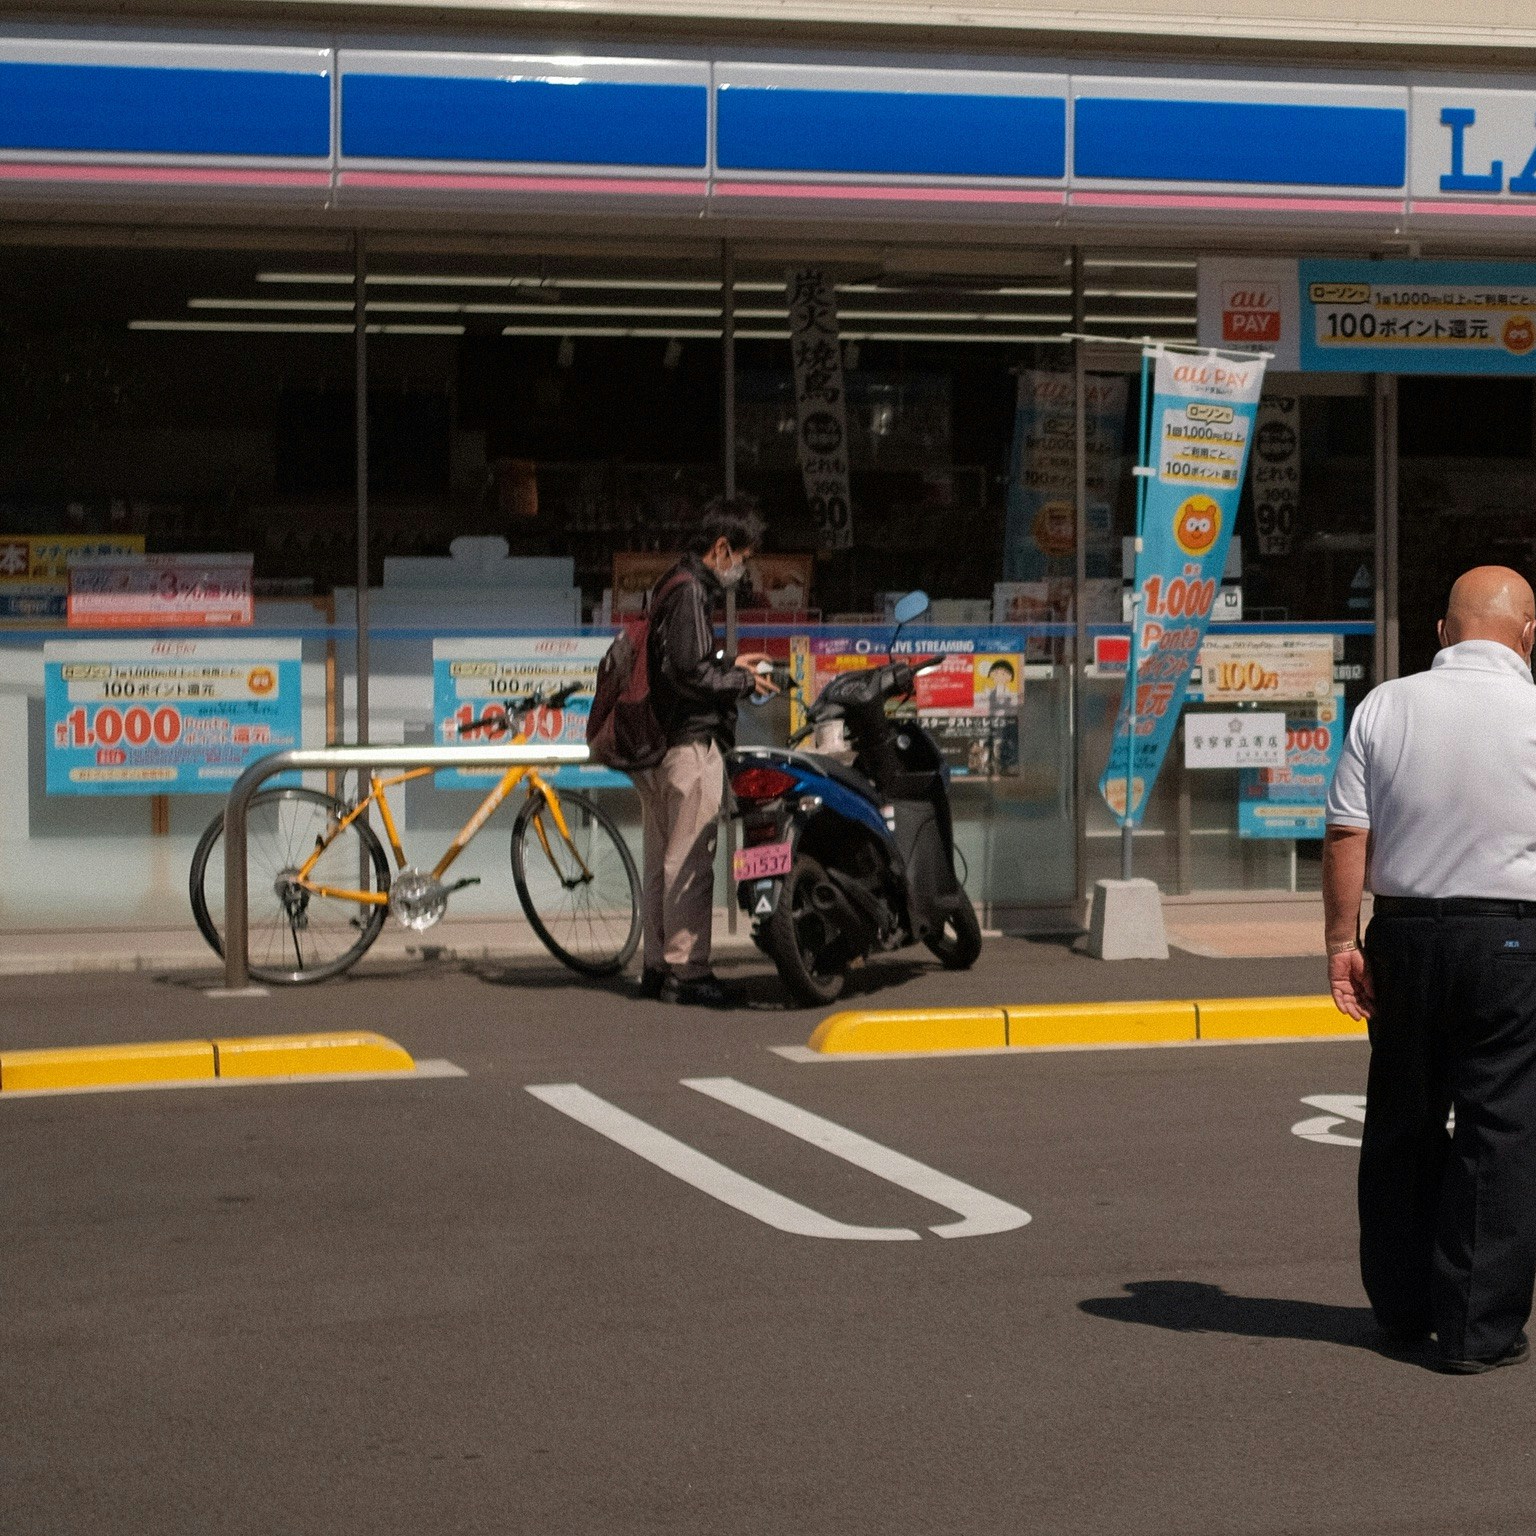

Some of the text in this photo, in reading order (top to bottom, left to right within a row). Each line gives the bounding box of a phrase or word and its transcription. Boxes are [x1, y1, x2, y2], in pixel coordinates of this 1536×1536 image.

[1230, 290, 1274, 309] au
[1231, 314, 1272, 333] PAY
[1173, 364, 1249, 387] au PAY
[1256, 503, 1298, 536] 90
[1143, 575, 1217, 618] 1,000
[915, 639, 975, 654] STREAMING
[1142, 623, 1200, 651] Ponta
[68, 706, 182, 746] 1,000
